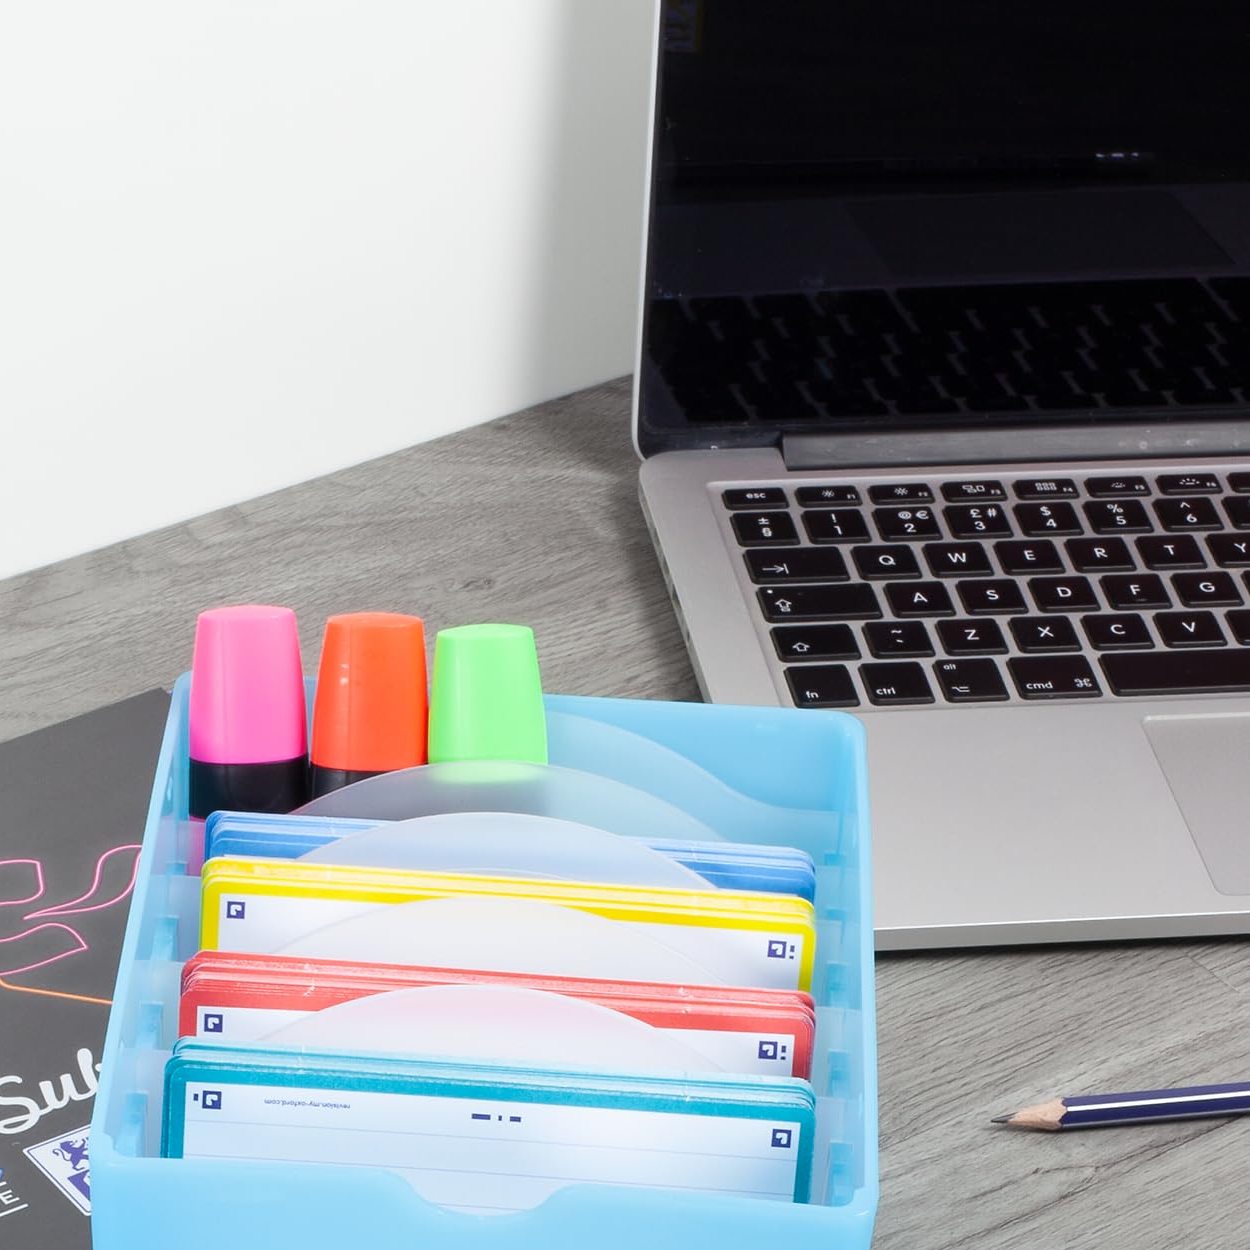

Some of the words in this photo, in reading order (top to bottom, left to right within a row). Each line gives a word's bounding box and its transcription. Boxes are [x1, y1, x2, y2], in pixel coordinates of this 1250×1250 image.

[1046, 518, 1057, 528] 4
[1116, 515, 1127, 525] 5
[1186, 513, 1198, 523] 6
[904, 523, 916, 533] 2
[974, 520, 986, 531] 3
[1093, 547, 1108, 558] R
[1163, 544, 1175, 555] T
[1234, 542, 1247, 553] Y
[878, 554, 896, 566] Q
[947, 552, 967, 563] W
[1023, 550, 1036, 561] E
[1056, 586, 1072, 598] D
[1129, 584, 1140, 595] F
[1199, 582, 1216, 593] G
[913, 591, 928, 603] A
[986, 589, 999, 600] S
[1037, 626, 1054, 638] X
[1110, 624, 1126, 635] C
[1181, 621, 1196, 633] V
[964, 629, 980, 641] Z
[876, 687, 896, 695] ctrl
[1026, 681, 1054, 690] cmd
[805, 690, 819, 699] fn
